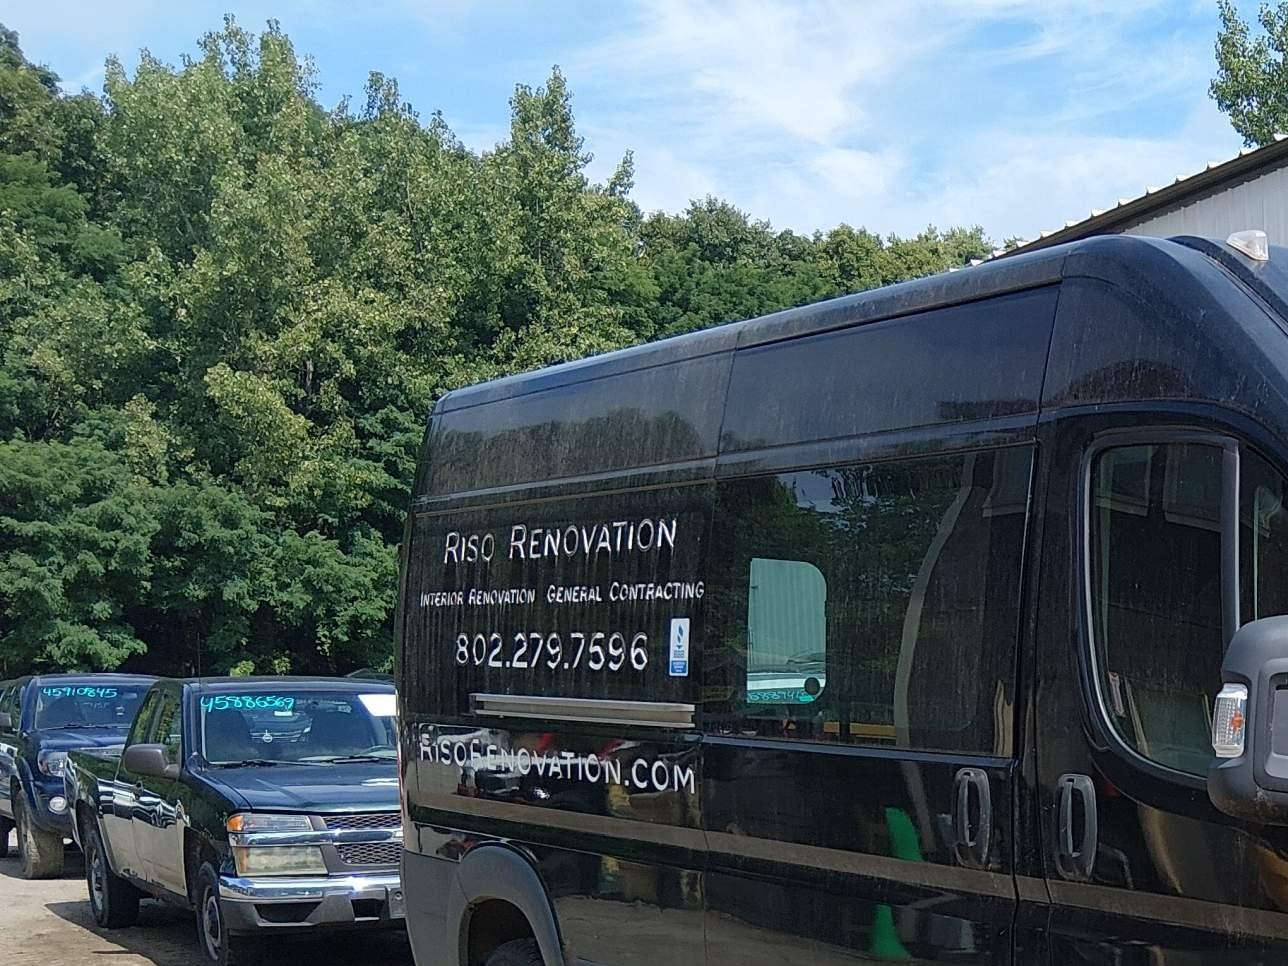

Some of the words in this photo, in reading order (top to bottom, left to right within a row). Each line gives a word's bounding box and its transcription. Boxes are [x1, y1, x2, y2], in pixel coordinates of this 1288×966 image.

[444, 531, 495, 564] RISO
[509, 518, 677, 559] RENOVATION
[420, 591, 464, 607] INTERIOR
[468, 588, 536, 605] RENOVATION
[547, 584, 603, 603] GENERAL
[609, 581, 705, 601] CONTRACTING
[455, 631, 648, 671] 802.279.7596
[200, 695, 294, 712] 45886569
[419, 738, 696, 794] RISORENOVATION.COM
